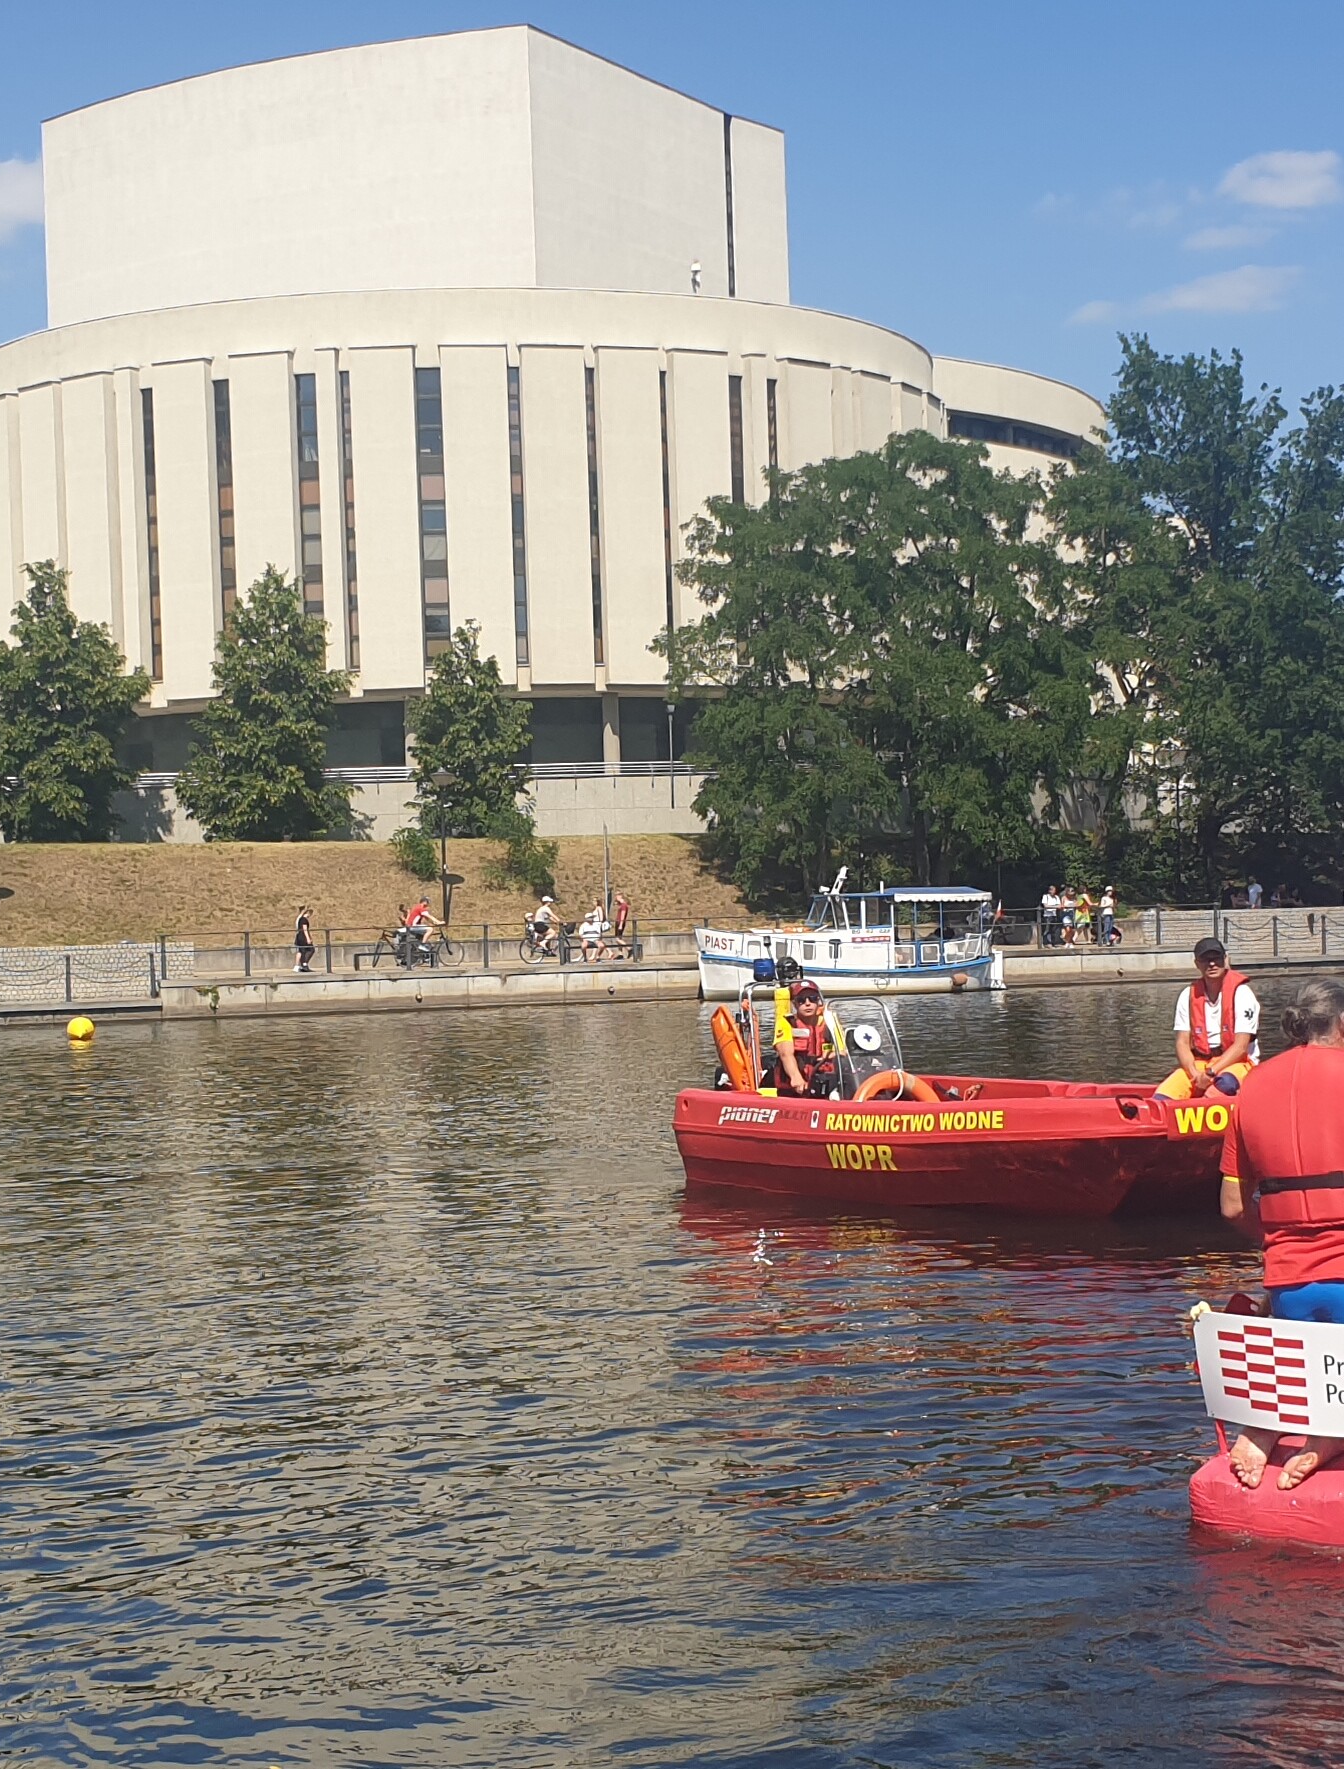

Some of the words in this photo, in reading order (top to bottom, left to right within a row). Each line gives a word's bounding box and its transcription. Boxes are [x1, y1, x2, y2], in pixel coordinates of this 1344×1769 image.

[704, 935, 735, 951] PIAST
[718, 1106, 779, 1126] pioner
[825, 1113, 935, 1133] RATOWNICTWO
[939, 1110, 1004, 1131] WODNE
[1175, 1104, 1235, 1135] WO
[826, 1143, 898, 1171] WOPR
